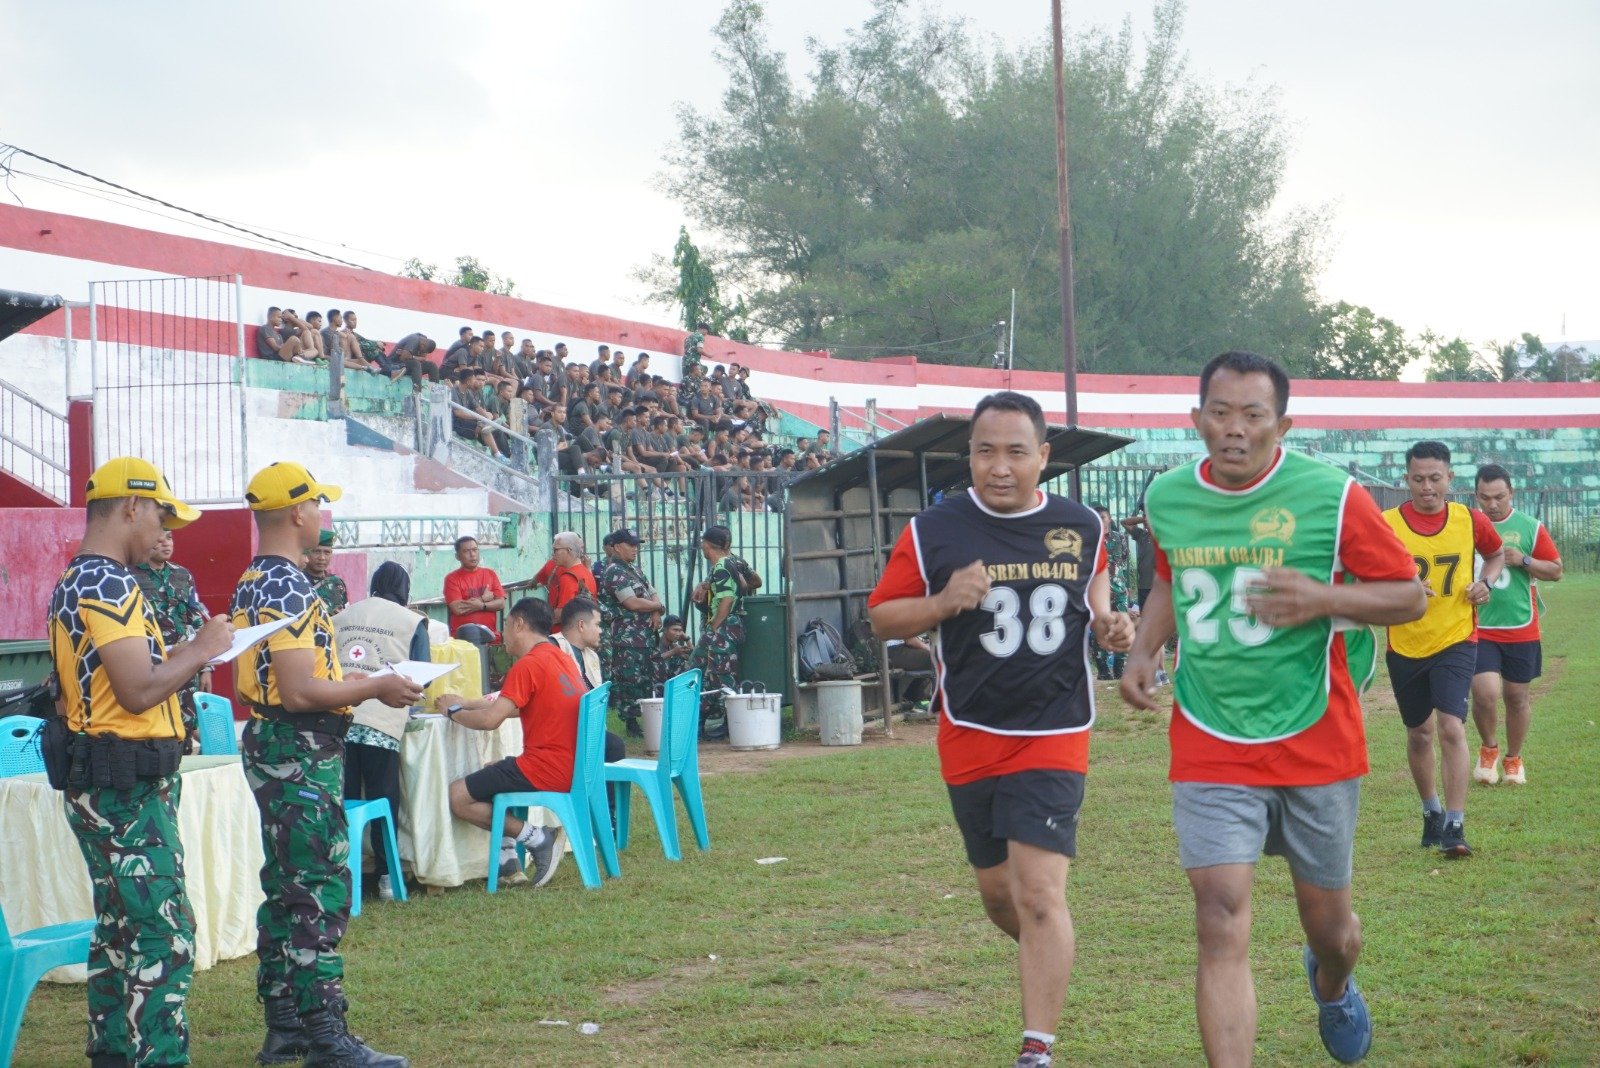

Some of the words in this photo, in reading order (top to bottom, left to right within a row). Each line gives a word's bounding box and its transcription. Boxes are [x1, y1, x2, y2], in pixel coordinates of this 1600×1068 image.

[1032, 561, 1079, 580] 084/BJ
[1229, 545, 1285, 568] 084/BJ
[978, 583, 1069, 658] 38
[1179, 566, 1275, 647] 25
